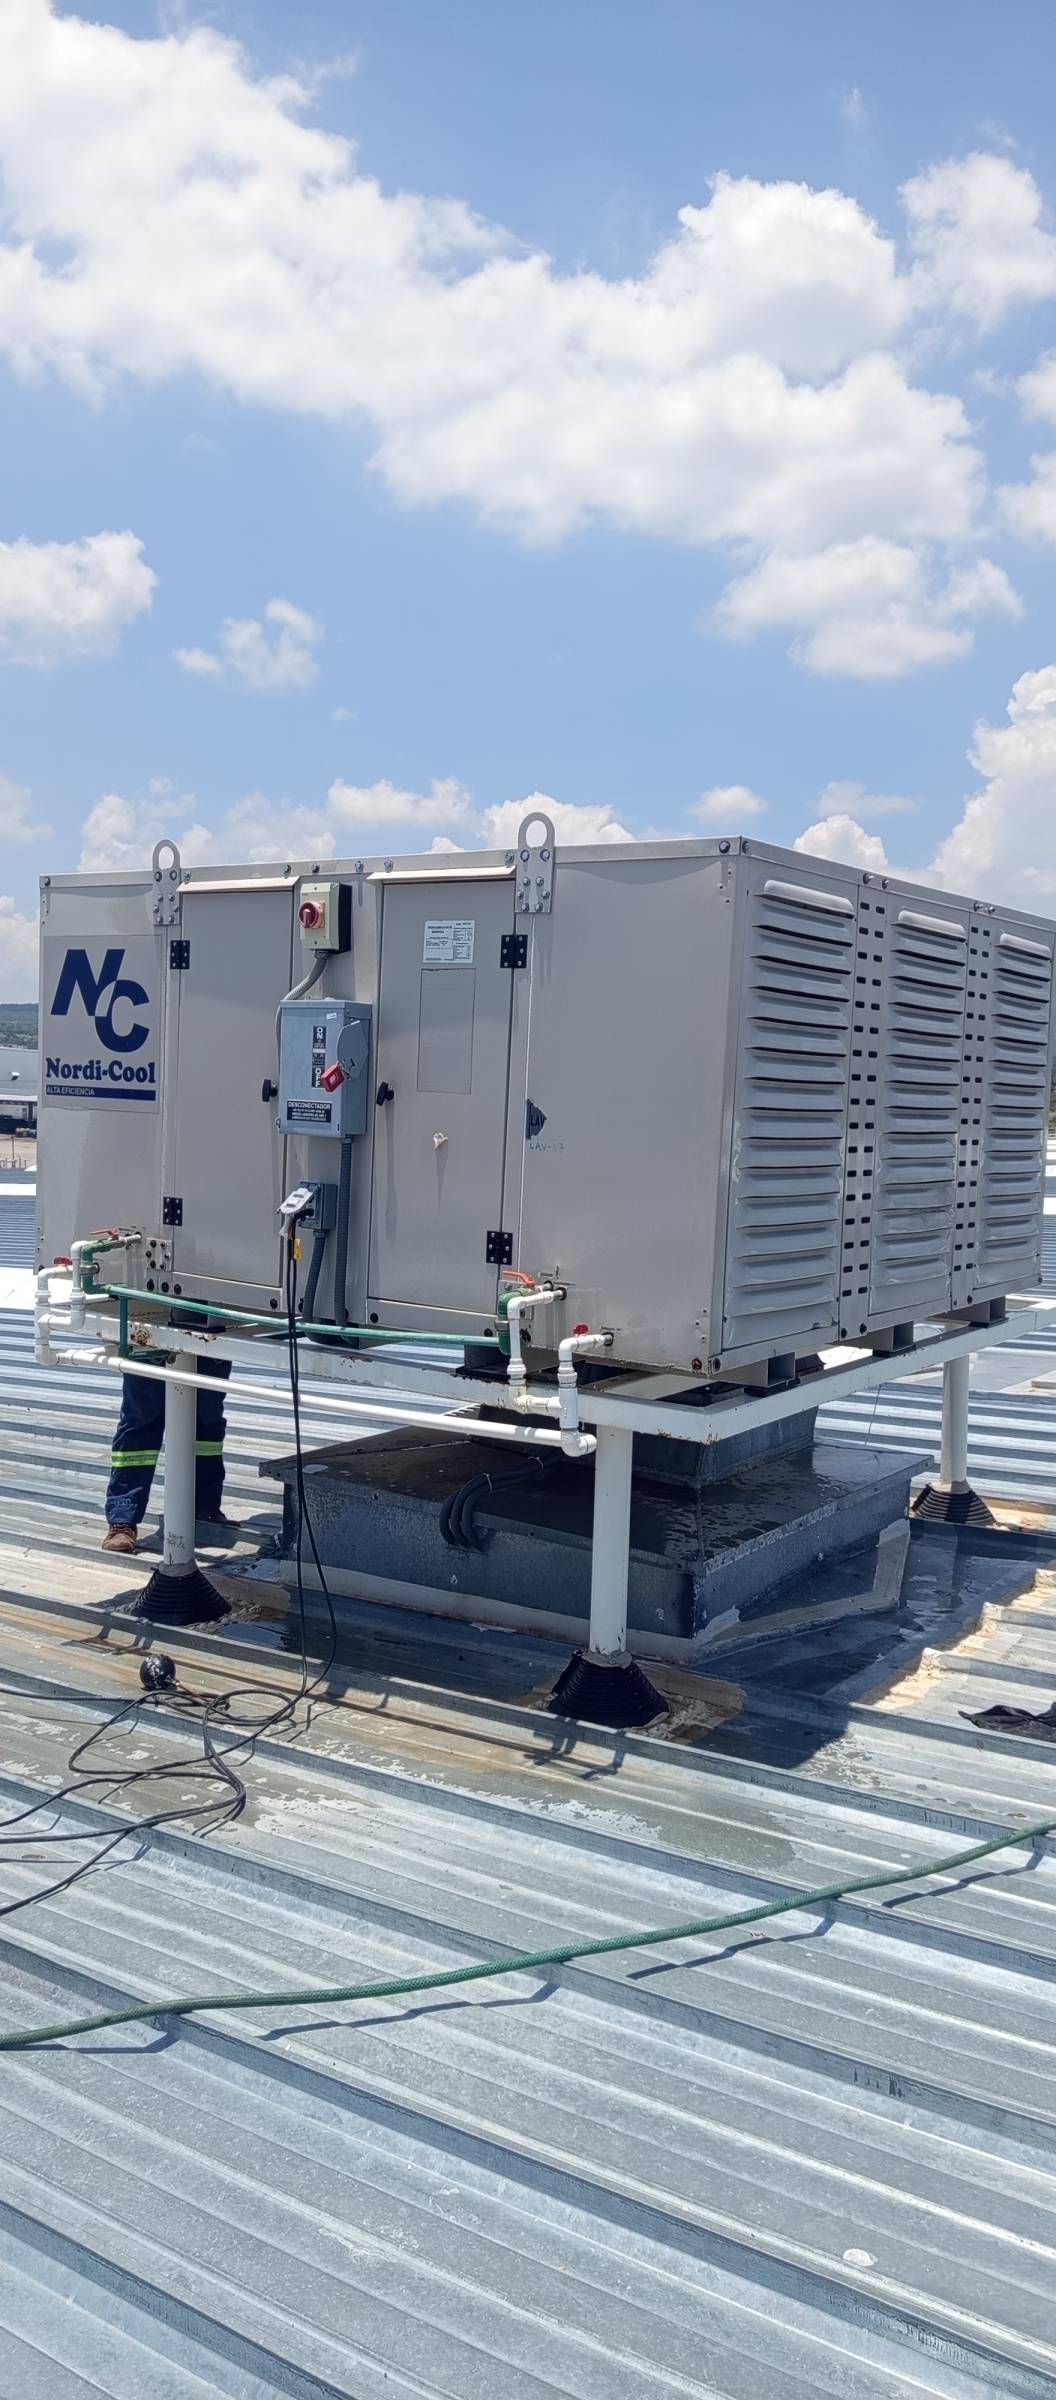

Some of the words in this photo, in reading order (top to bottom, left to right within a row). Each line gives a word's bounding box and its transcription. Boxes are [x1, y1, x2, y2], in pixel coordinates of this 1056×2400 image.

[50, 948, 150, 1053] NC
[316, 1026, 324, 1039] ON
[46, 1057, 156, 1084] Nordi-Cool
[46, 1086, 61, 1094] ALTA
[62, 1087, 95, 1096] EFICIENCIA
[288, 1101, 331, 1109] DESCONECTADOR
